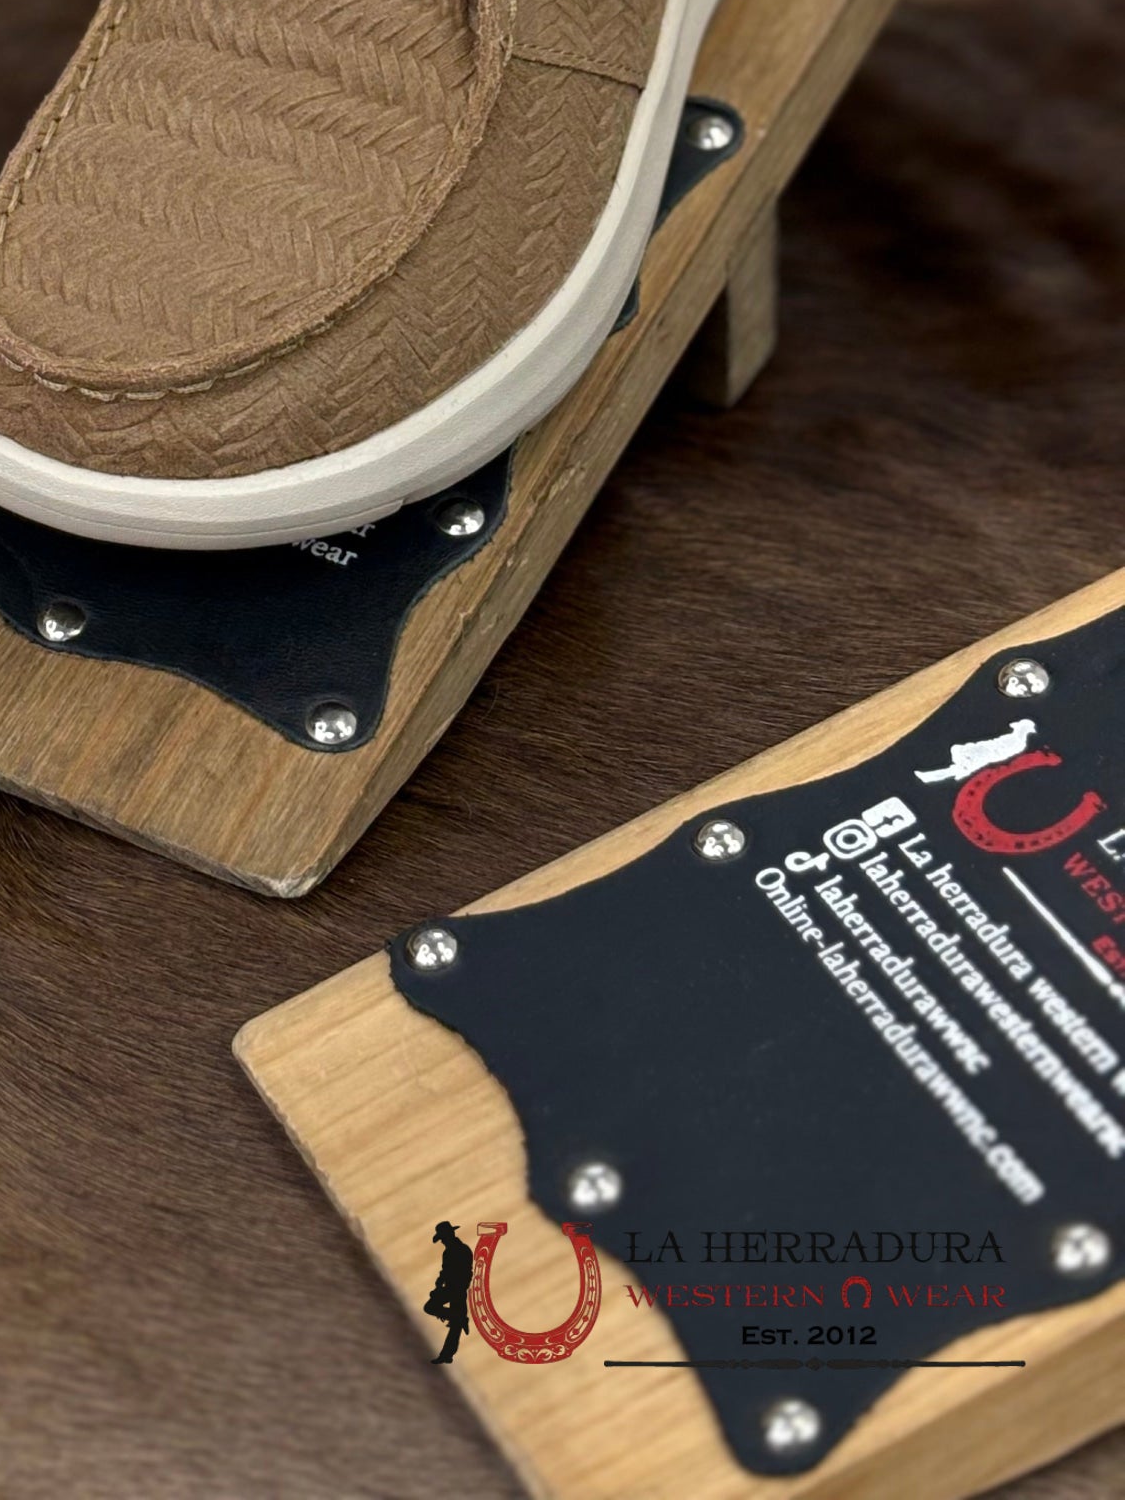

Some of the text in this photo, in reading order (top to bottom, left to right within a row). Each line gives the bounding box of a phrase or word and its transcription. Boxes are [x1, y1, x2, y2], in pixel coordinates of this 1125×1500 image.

[898, 833, 1119, 1074] La herradura western
